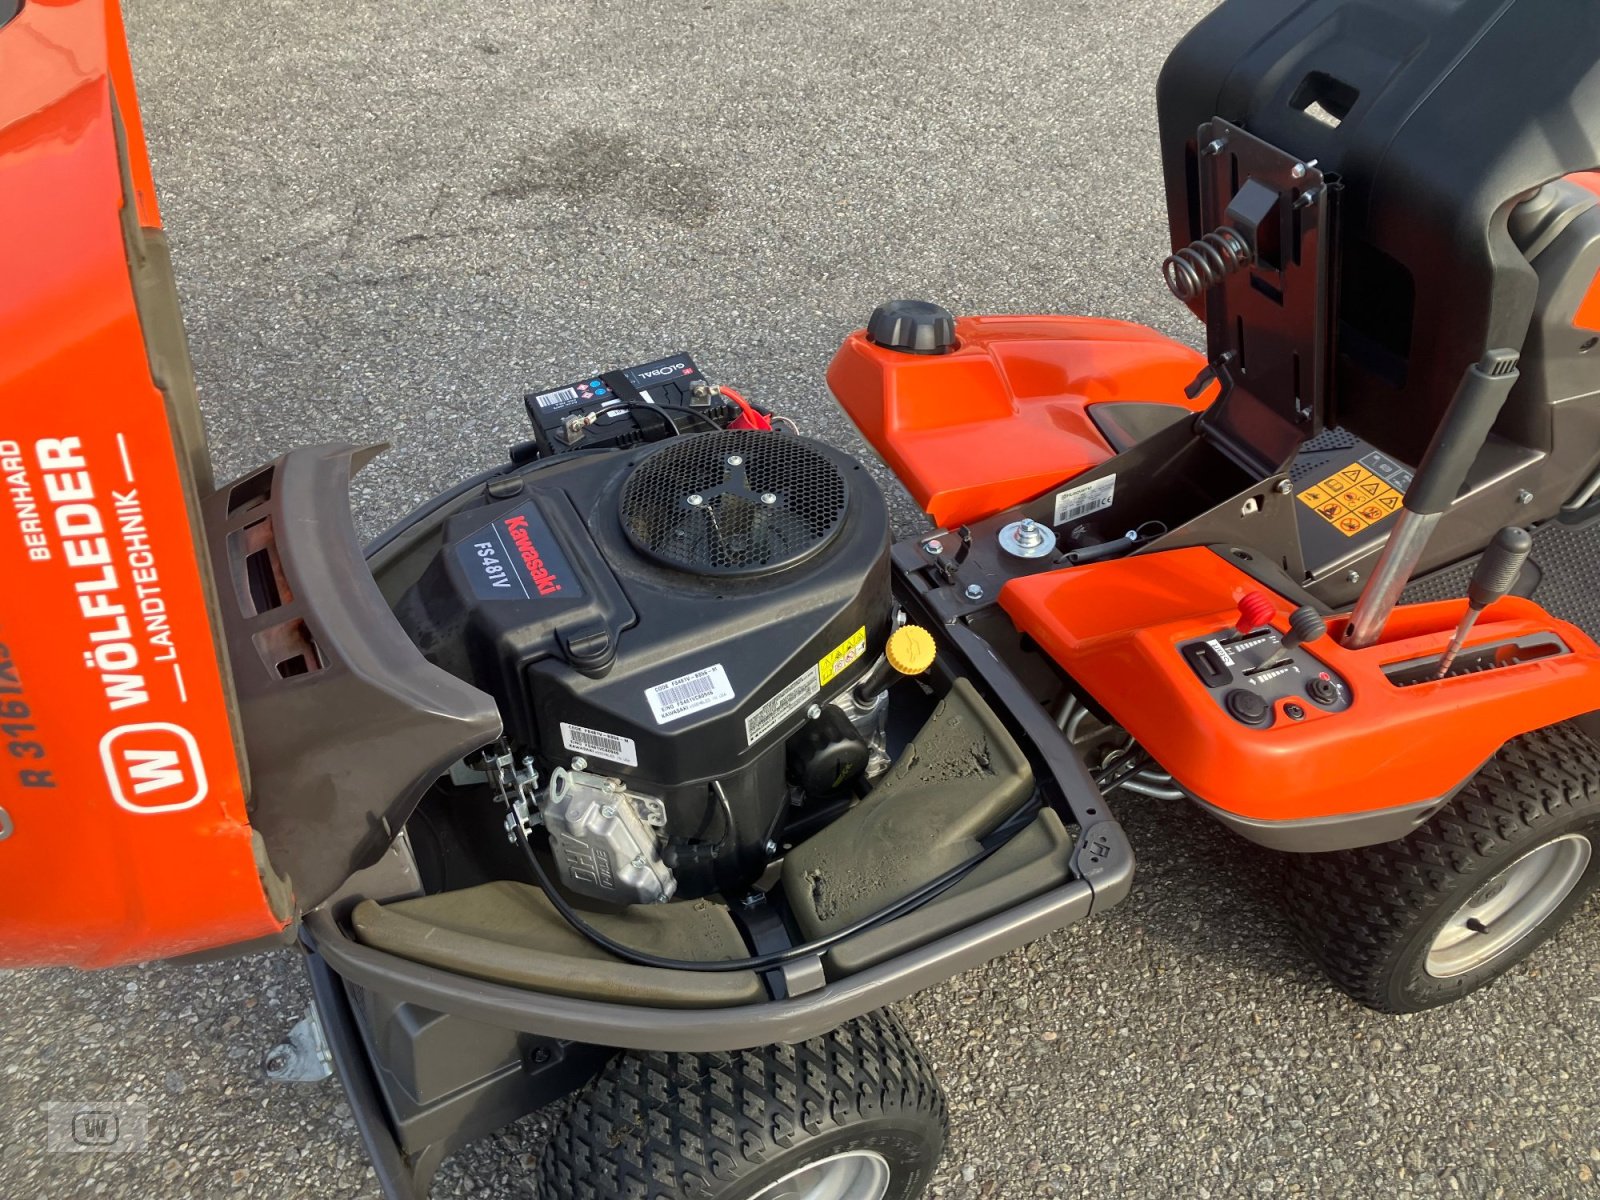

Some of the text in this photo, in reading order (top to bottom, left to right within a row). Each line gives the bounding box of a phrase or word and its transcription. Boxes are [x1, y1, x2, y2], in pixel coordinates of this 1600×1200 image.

[638, 363, 685, 379] GLOBAL
[0, 440, 52, 561] BERNHARD
[35, 436, 150, 711] WÖLFLEDER
[112, 489, 178, 663] LANDTECHNIK
[474, 542, 511, 588] FS481V
[504, 515, 562, 596] Kawasaki
[655, 684, 669, 692] CODE
[661, 706, 689, 718] KAWASAKI
[19, 769, 57, 788] R
[124, 749, 185, 795] W
